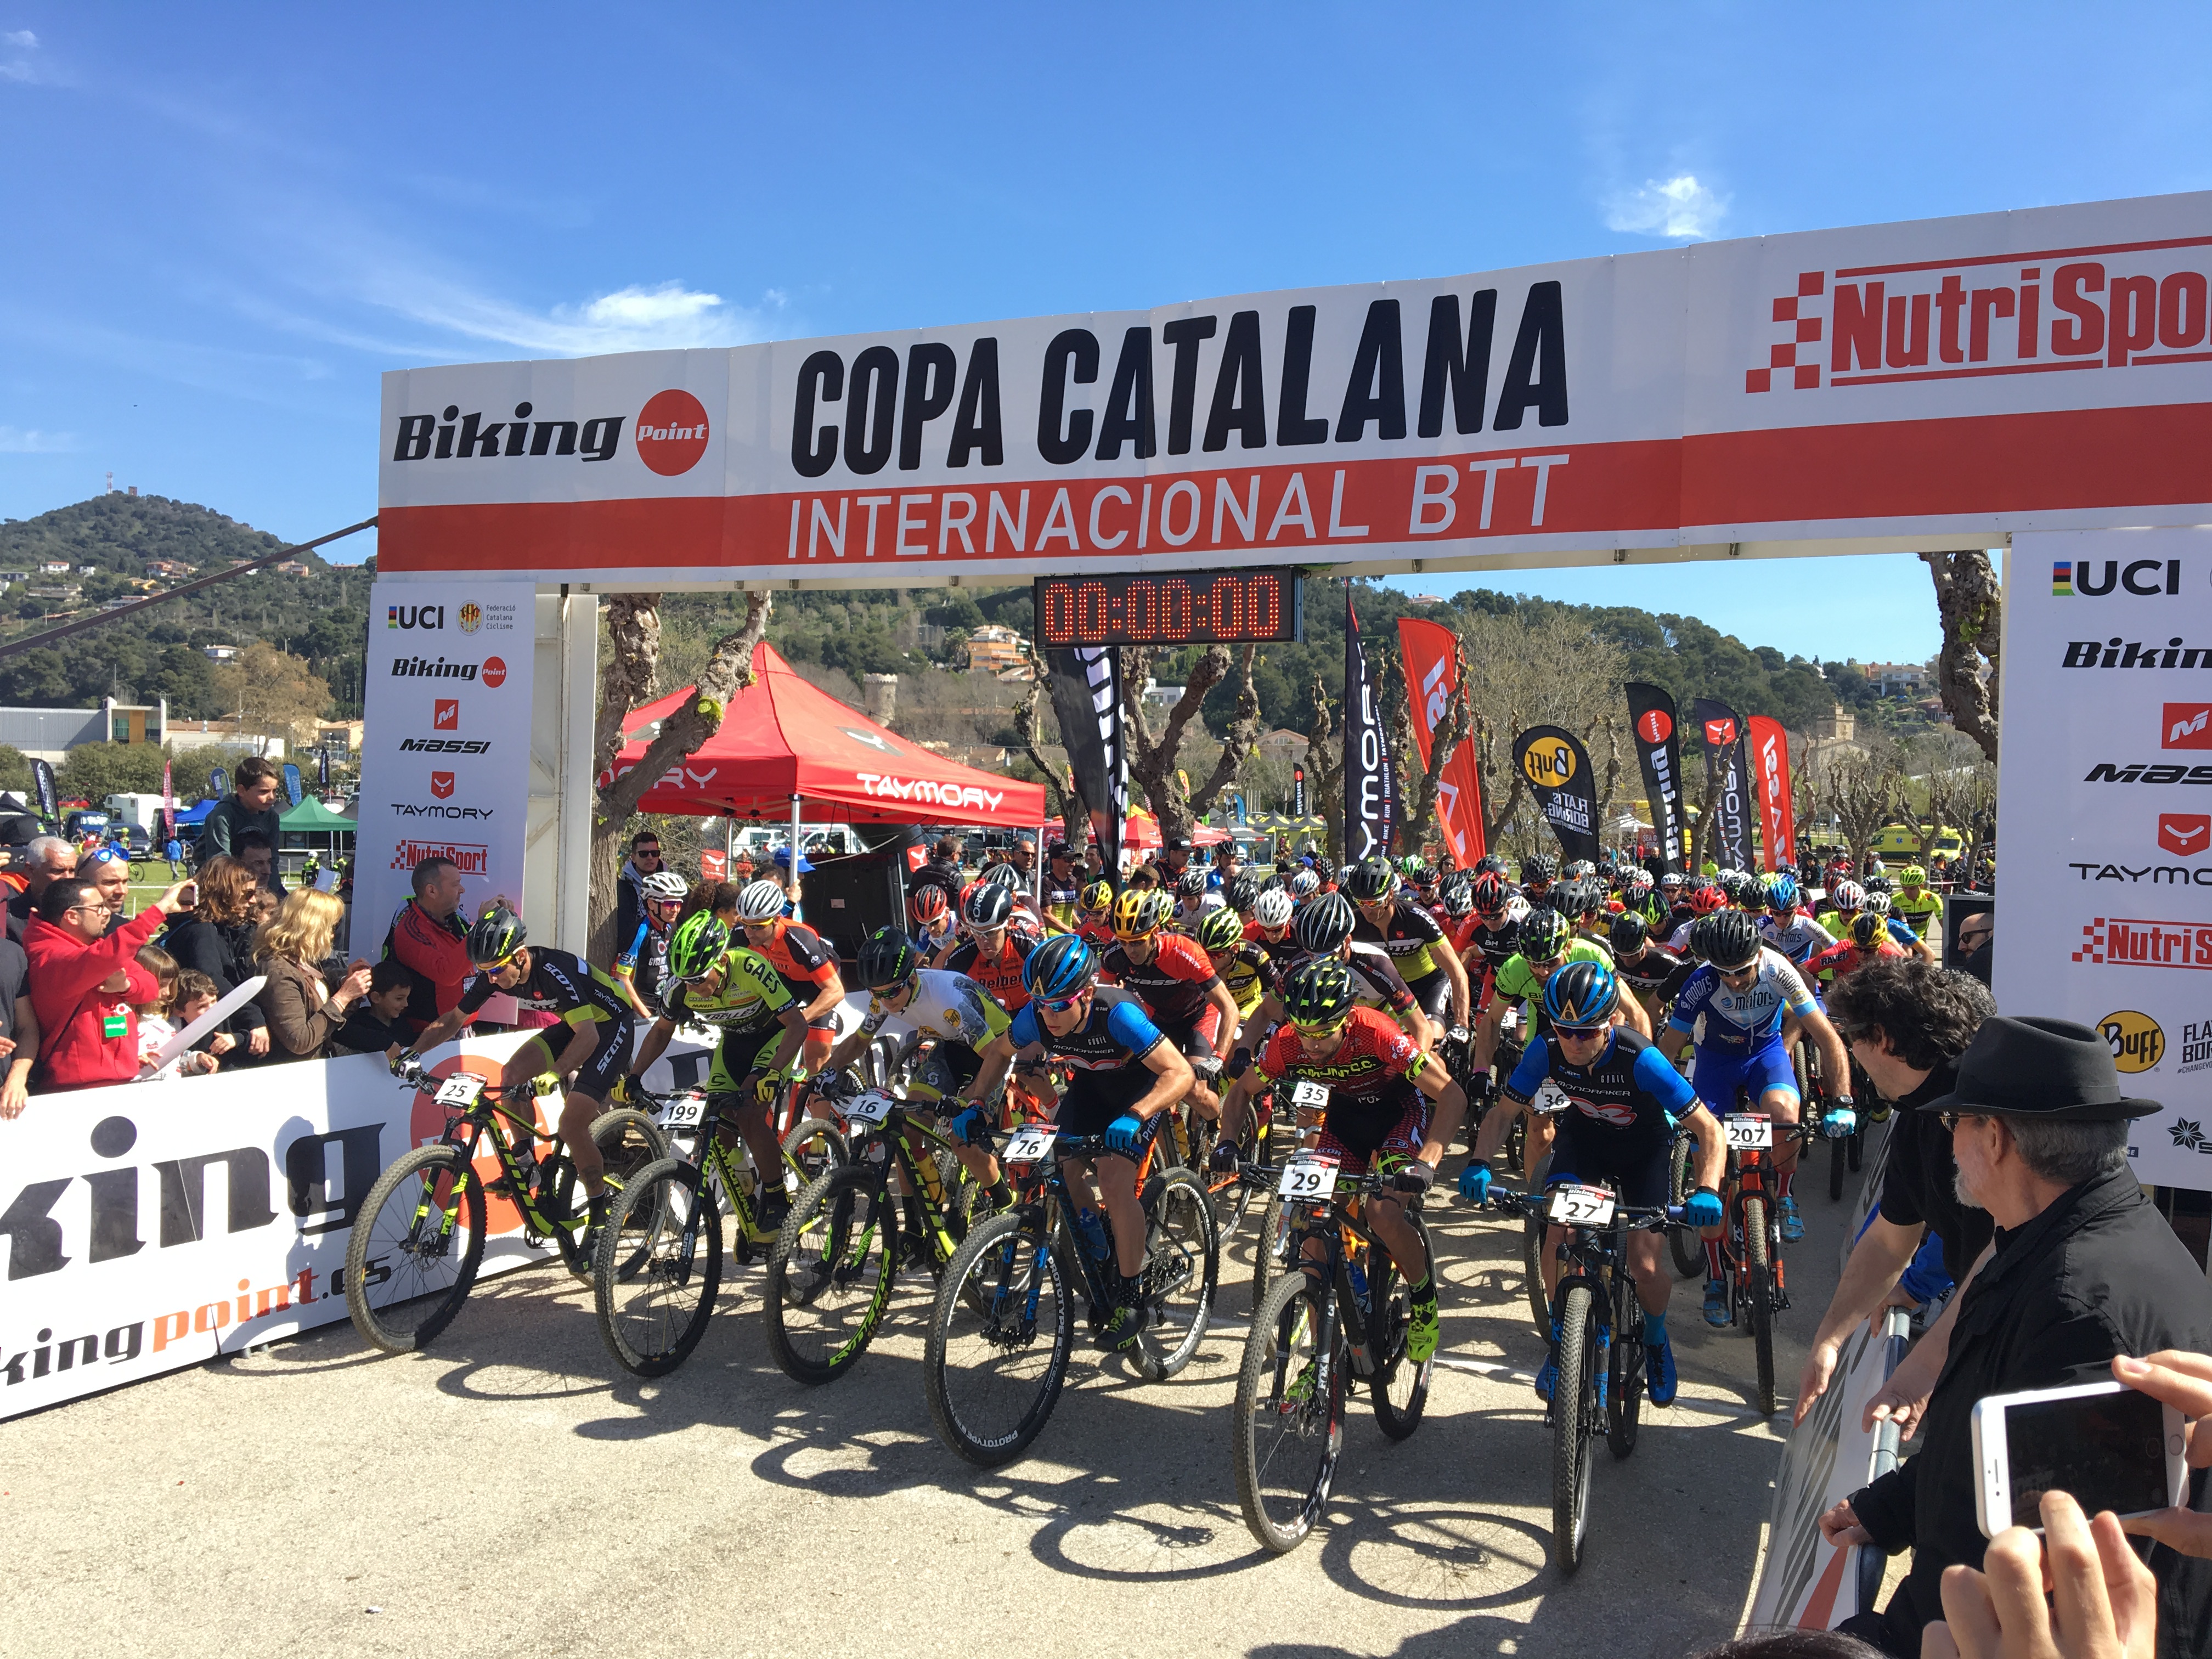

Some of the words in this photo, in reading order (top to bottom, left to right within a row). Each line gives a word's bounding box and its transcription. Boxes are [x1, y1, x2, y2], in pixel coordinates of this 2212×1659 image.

[1831, 262, 2212, 371] NutriSpo
[791, 338, 1004, 477] COPA
[1037, 280, 1569, 466] CATALANA
[393, 402, 627, 462] Biking
[638, 421, 708, 441] Point
[789, 471, 1370, 558] INTERNACIONAL
[1408, 453, 1570, 535] BTT
[2076, 559, 2180, 596] UCI
[399, 606, 444, 629] UCI
[1045, 574, 1280, 641] 00:00:00
[391, 656, 478, 681] Biking
[482, 667, 506, 676] Point
[857, 773, 1003, 811] TAYMORY
[1383, 762, 1392, 798] TRIATHLON
[391, 804, 493, 820] TAYMORY
[973, 883, 995, 918] ORBEA
[1409, 907, 1443, 936] SCOTT
[543, 962, 580, 1003] SCOTT
[743, 956, 781, 994] GAES
[1684, 975, 1713, 1005] motors
[596, 1022, 627, 1075] SCOTT
[444, 1085, 469, 1098] 25
[1302, 1088, 1325, 1101] 35
[1544, 1093, 1565, 1108] 36
[1556, 1080, 1631, 1097] MONDRAKER
[668, 1105, 697, 1120] 199
[858, 1099, 879, 1114] 16
[1015, 1139, 1041, 1155] 76
[1729, 1129, 1765, 1143] 207
[1291, 1172, 1321, 1192] 29
[1568, 1189, 1596, 1197] Biking
[1565, 1201, 1599, 1218] 27
[1047, 1255, 1065, 1334] PROTOTYPE
[1317, 1364, 1329, 1390] FOX
[967, 1430, 1019, 1448] PROTOTYPE
